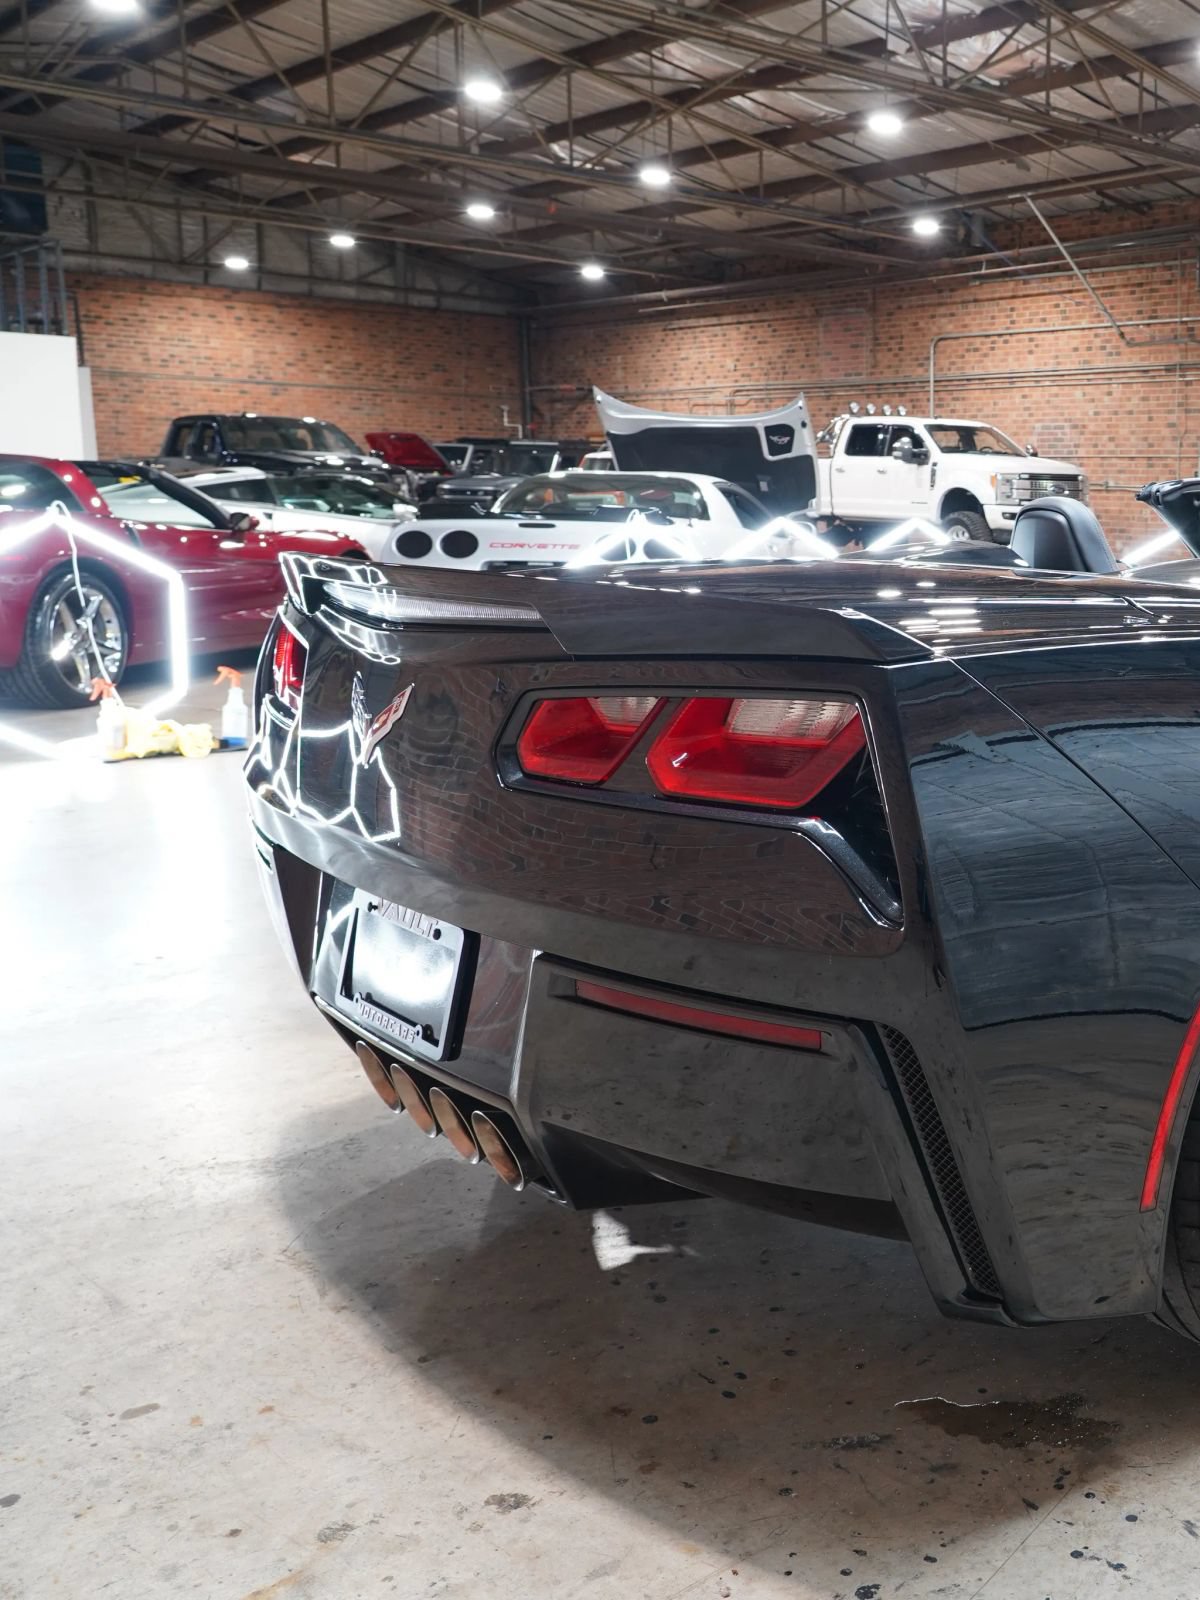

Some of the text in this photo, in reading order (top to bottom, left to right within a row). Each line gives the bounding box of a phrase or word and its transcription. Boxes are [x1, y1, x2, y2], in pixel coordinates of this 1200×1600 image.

[489, 542, 580, 550] CORVETTE
[378, 897, 439, 938] VAULT
[359, 1003, 416, 1043] MOTORCARS
